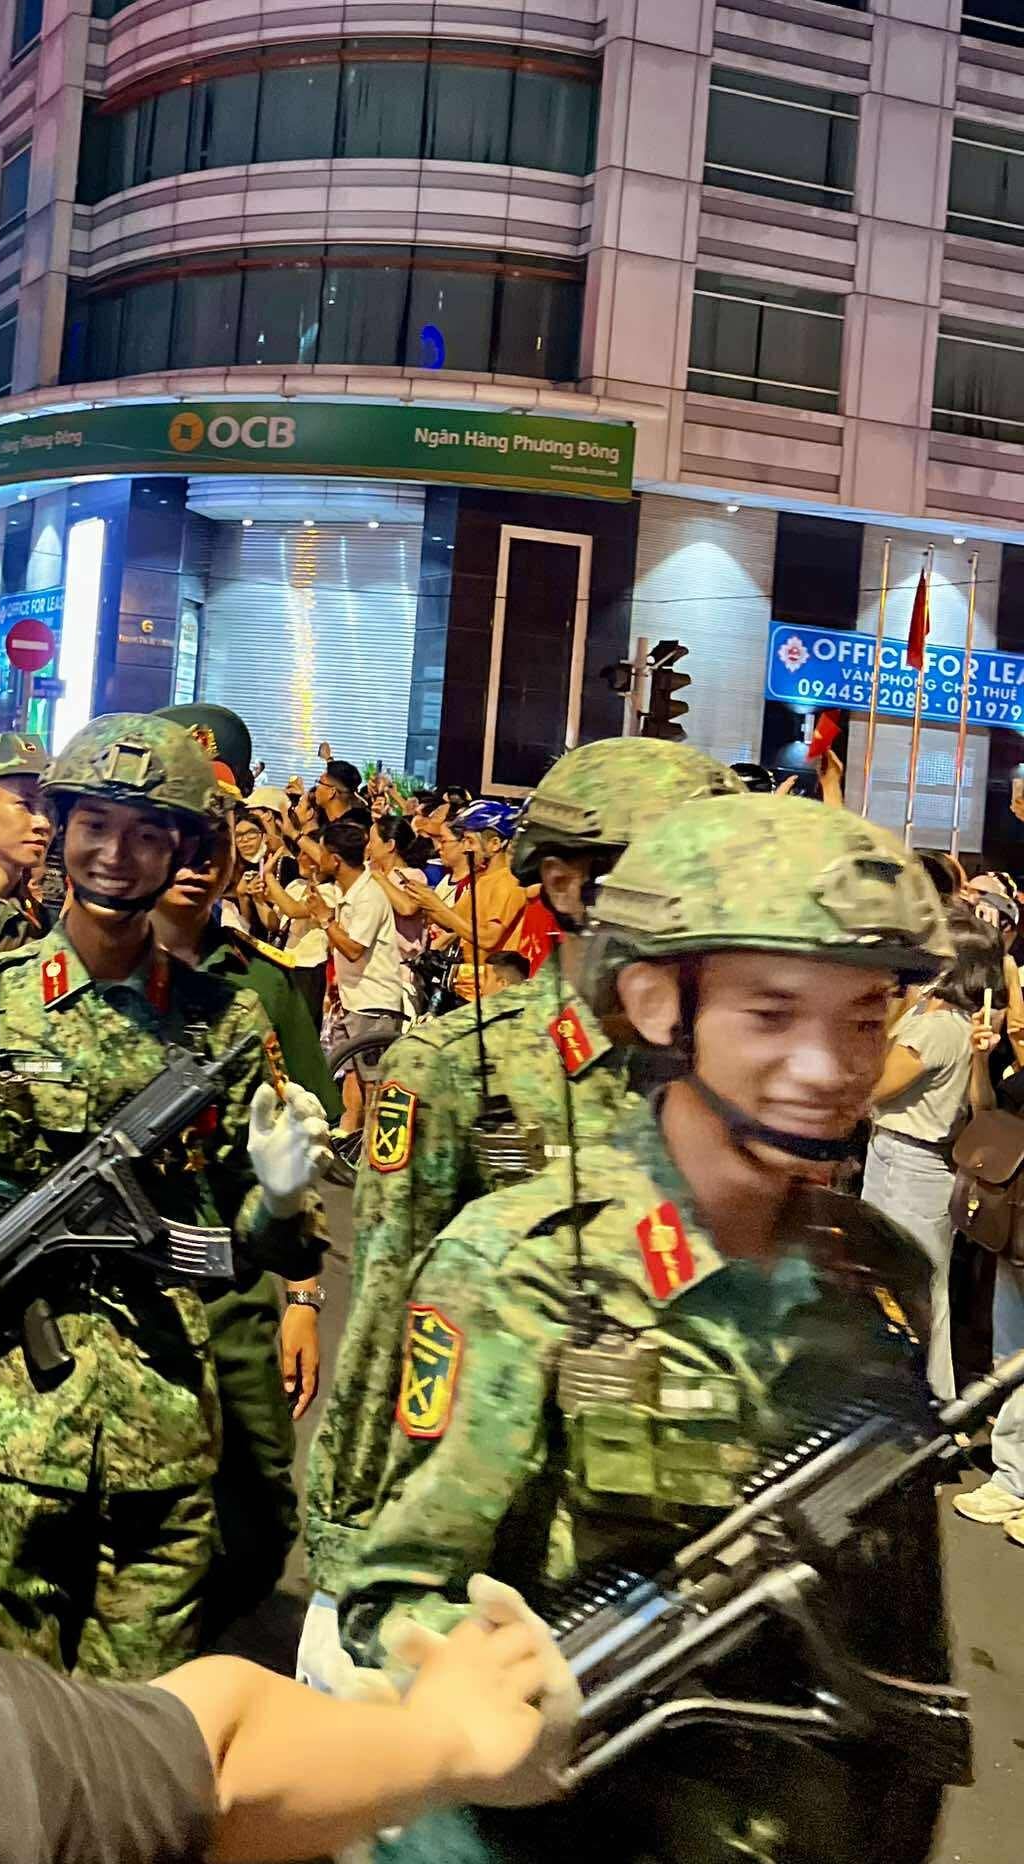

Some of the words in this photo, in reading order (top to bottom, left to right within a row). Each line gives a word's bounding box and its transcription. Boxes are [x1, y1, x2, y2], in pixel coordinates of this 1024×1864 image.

[207, 415, 296, 448] OCB
[414, 427, 460, 448] Ngân
[464, 431, 509, 453] Hàng
[512, 434, 574, 459] Phương
[577, 441, 620, 464] Đông
[922, 652, 979, 680] FOR
[947, 697, 1022, 721] 01979
